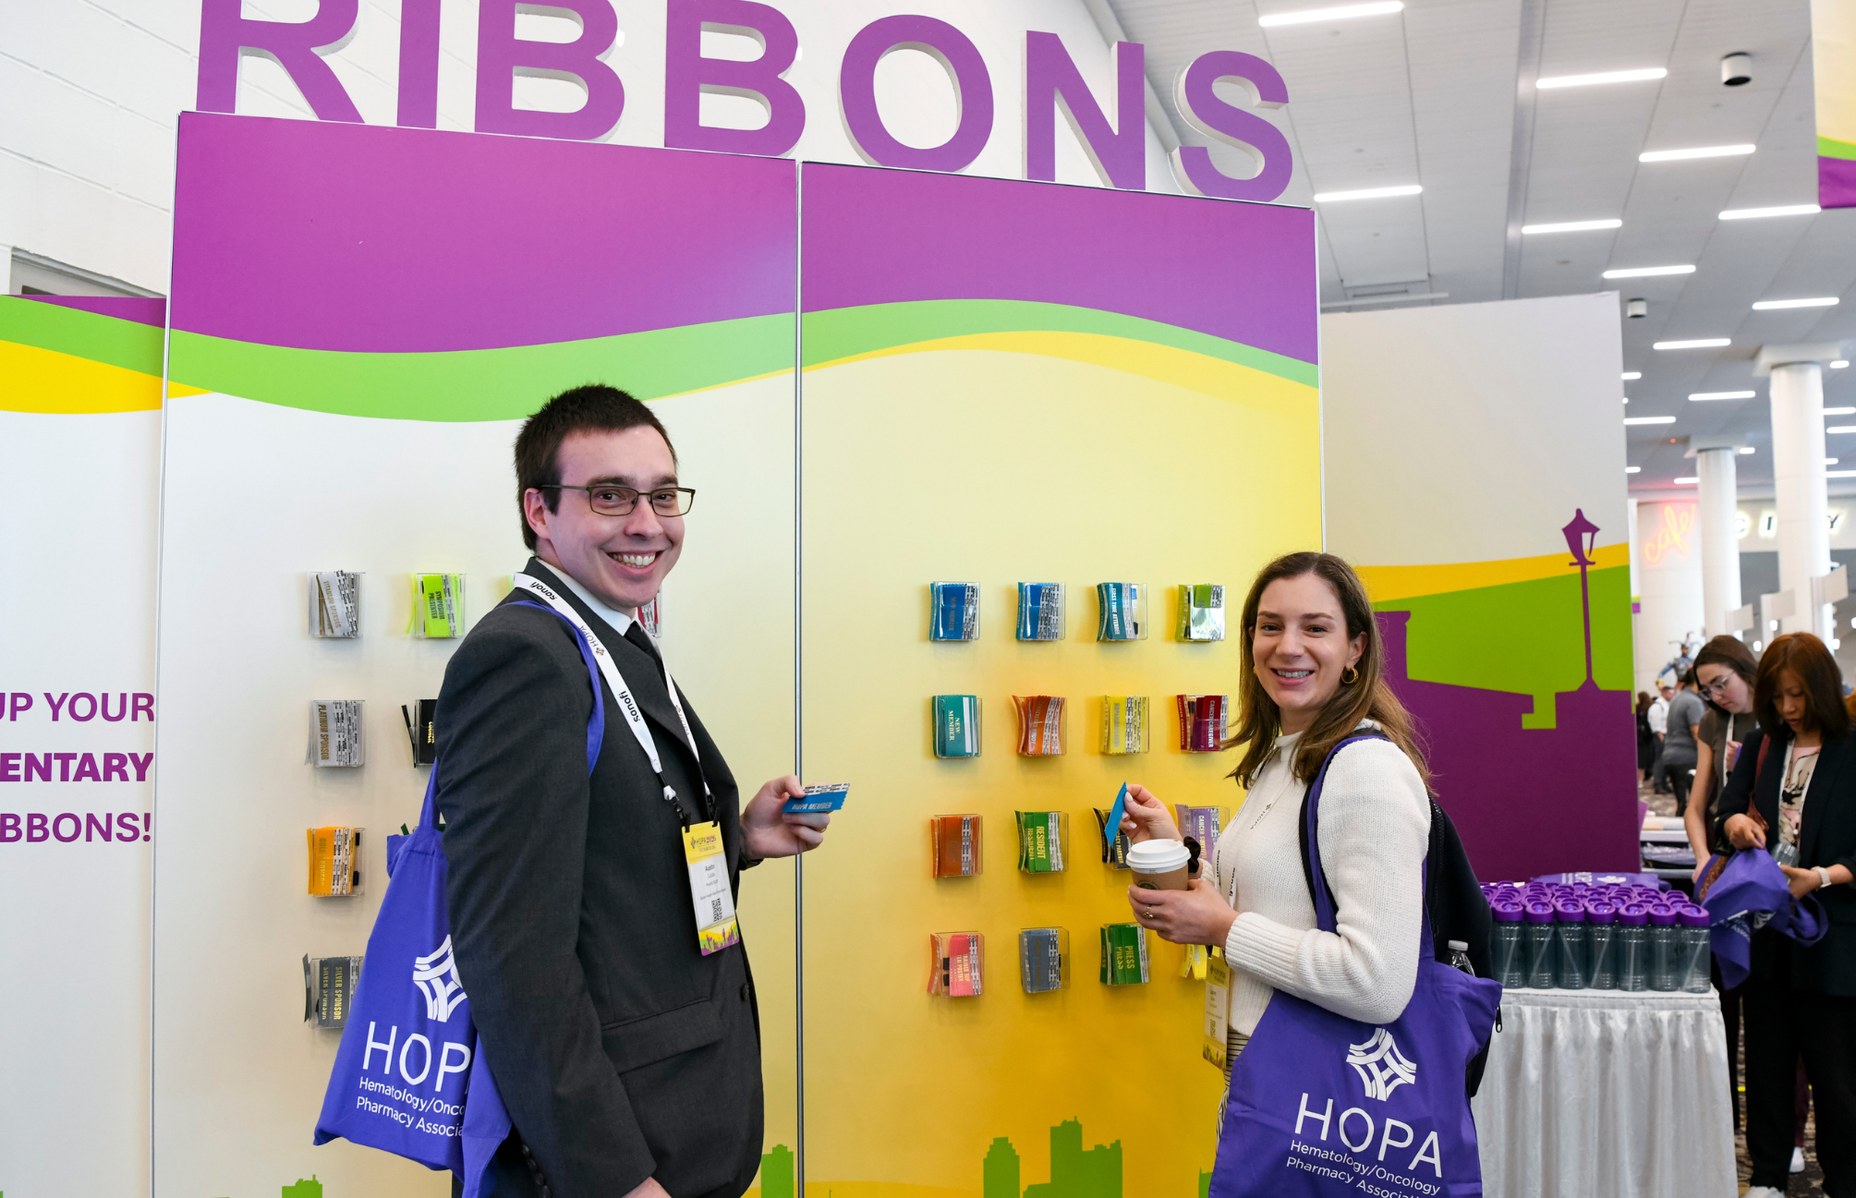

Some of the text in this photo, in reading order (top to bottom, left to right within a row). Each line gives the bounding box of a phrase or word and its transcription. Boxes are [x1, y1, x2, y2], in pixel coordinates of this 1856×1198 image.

[197, 0, 1293, 201] RIBBONS
[530, 581, 558, 600] sanofi
[0, 692, 155, 722] P YOUR
[618, 690, 641, 722] sanofi
[318, 704, 330, 761] PLATINUM SPONSOR
[948, 710, 956, 741] MEMBER
[0, 752, 154, 782] ENTARY
[0, 812, 152, 843] BBONS!
[1036, 826, 1046, 859] RESIDENT
[1125, 945, 1135, 969] PRESS
[333, 966, 343, 1020] SILVER SPONSOR
[362, 1021, 470, 1095] HOP
[356, 1096, 414, 1128] Pharmacy
[1294, 1092, 1443, 1178] HOPA
[1286, 1156, 1354, 1184] Pharmacy
[1290, 1139, 1441, 1196] Hematology/Oncology
